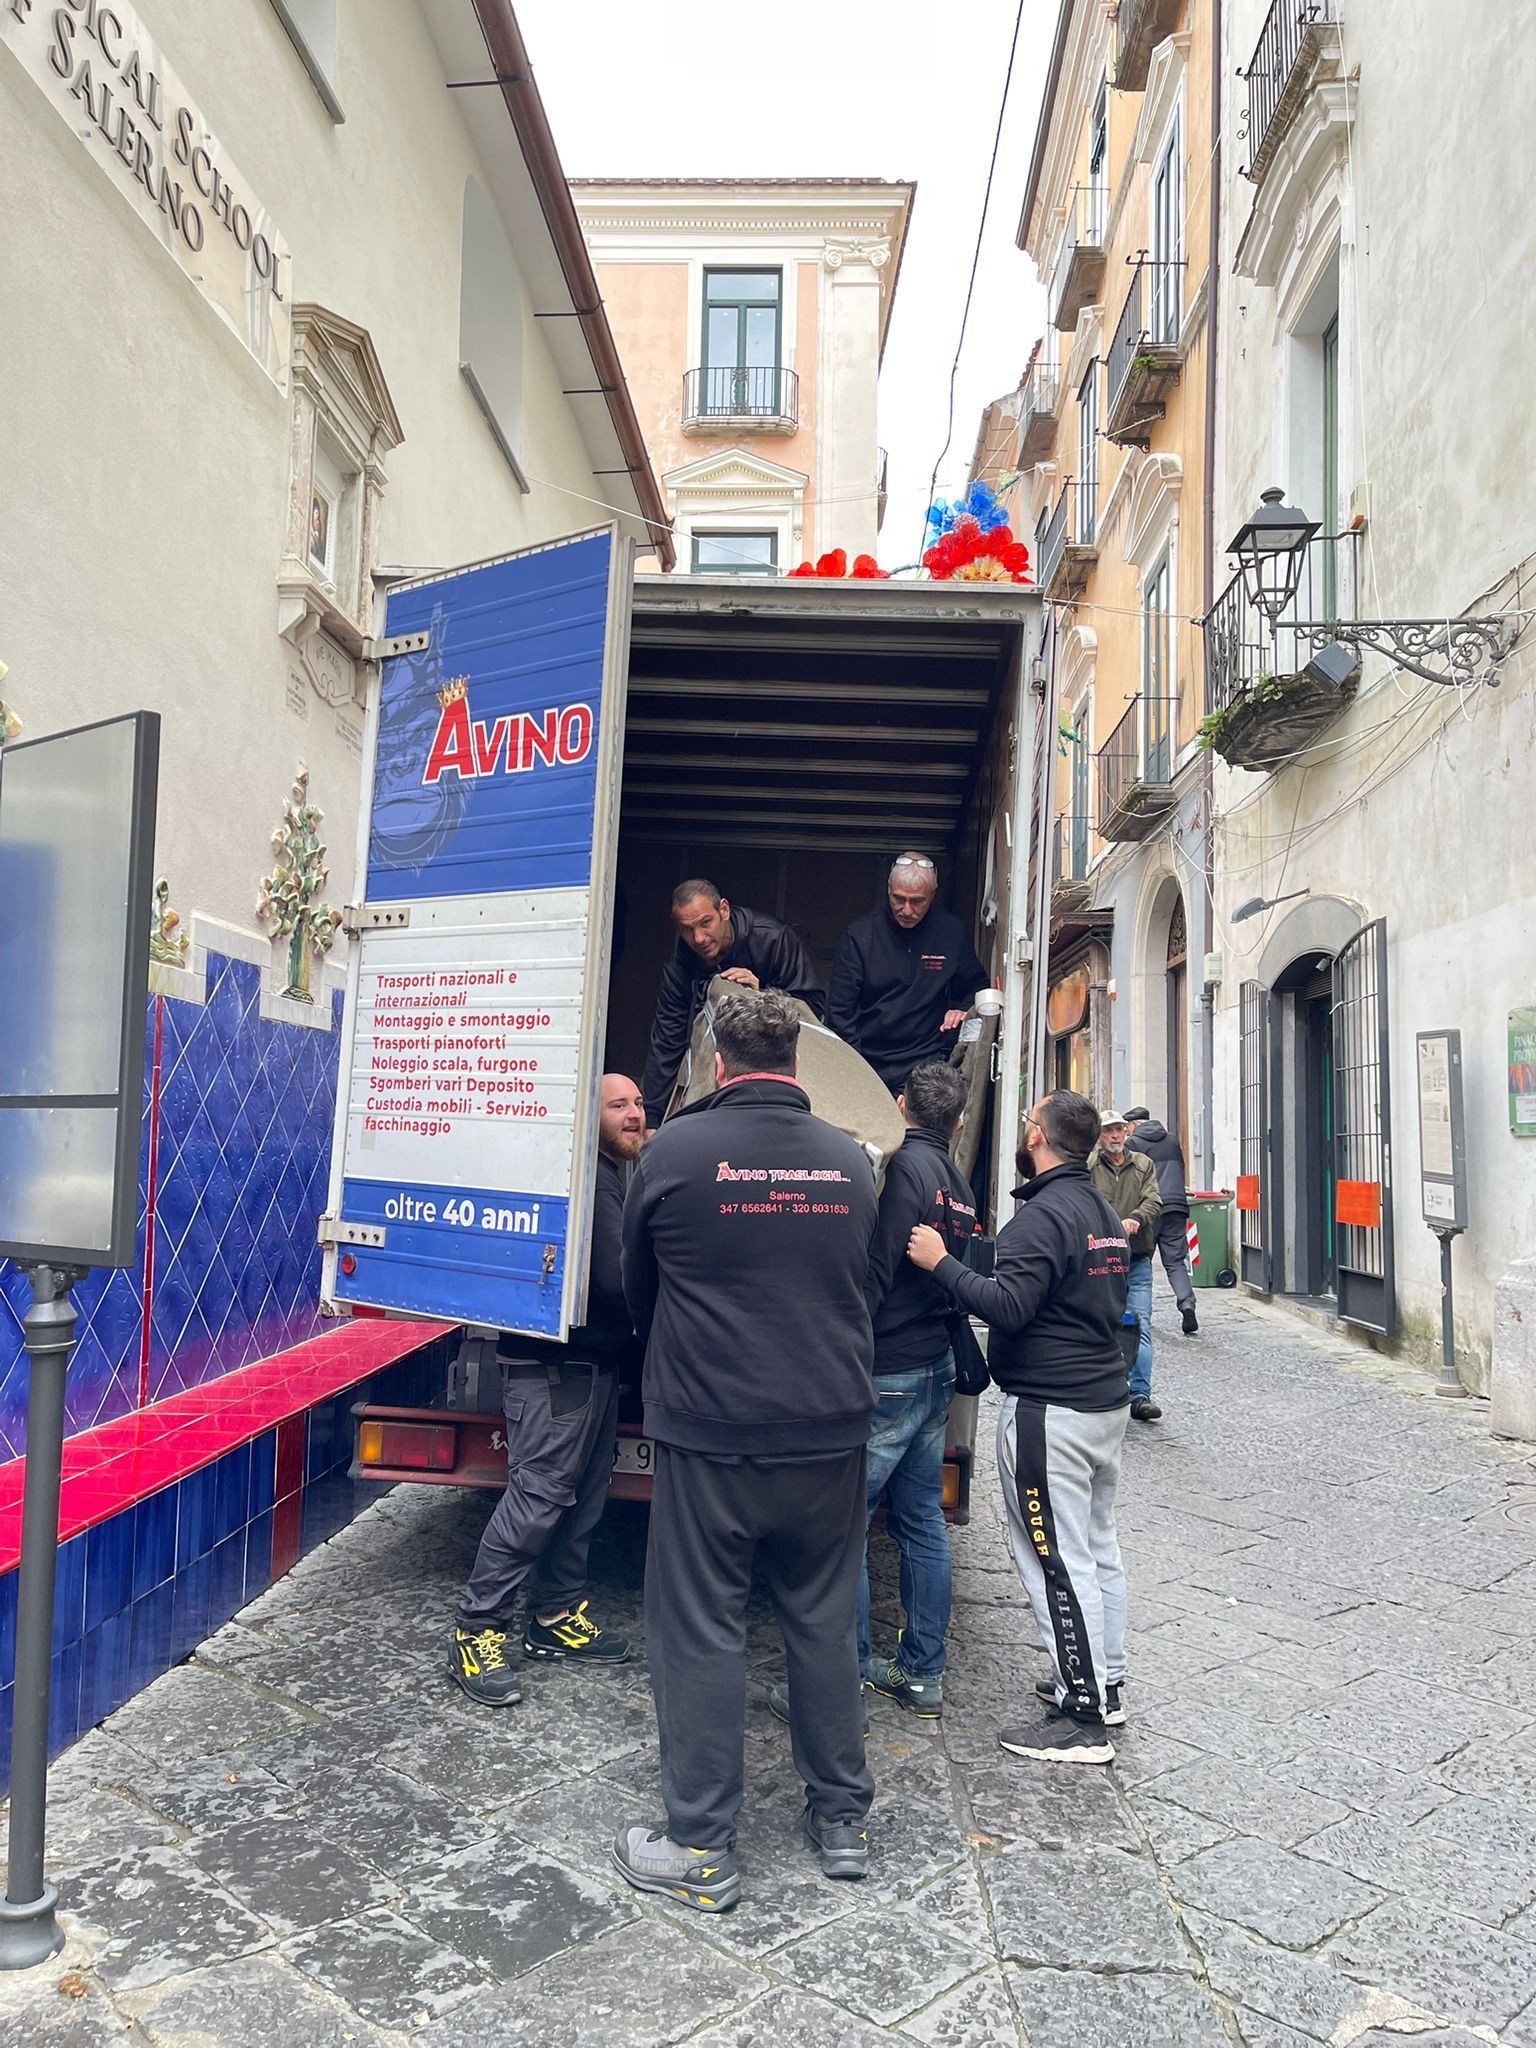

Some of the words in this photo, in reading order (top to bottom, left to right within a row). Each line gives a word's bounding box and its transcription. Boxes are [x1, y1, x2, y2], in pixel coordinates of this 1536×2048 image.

[47, 8, 204, 251] SALERNO
[64, 0, 163, 131] ICAL
[172, 106, 284, 302] SCHOOL
[422, 696, 593, 785] AVINO
[377, 972, 436, 990] Trasporti
[439, 969, 504, 987] nazionali
[508, 973, 517, 984] e
[374, 991, 467, 1008] internazionali
[373, 1012, 444, 1031] Montaggio
[447, 1016, 456, 1027] e
[460, 1008, 551, 1030] smontaggio
[372, 1035, 430, 1052] Trasporti
[434, 1034, 506, 1052] pianoforti
[371, 1055, 429, 1073] Noleggio
[432, 1057, 473, 1074] scala,
[477, 1056, 538, 1074] furgone
[369, 1076, 431, 1092] Sgomberi
[435, 1076, 462, 1091] vari
[466, 1077, 535, 1095] Deposito
[367, 1097, 422, 1111] Custodia
[426, 1098, 472, 1114] mobili
[486, 1101, 548, 1118] Servizio
[364, 1116, 451, 1136] facchinaggio
[716, 1165, 767, 1181] AVINO
[769, 1191, 806, 1201] Salerno
[384, 1192, 436, 1223] oltre
[442, 1199, 475, 1227] 40
[481, 1203, 541, 1235] anni
[720, 1204, 738, 1214] 347
[741, 1203, 783, 1213] 6562641
[792, 1203, 810, 1213] 320
[1026, 1487, 1049, 1557] TOUGH
